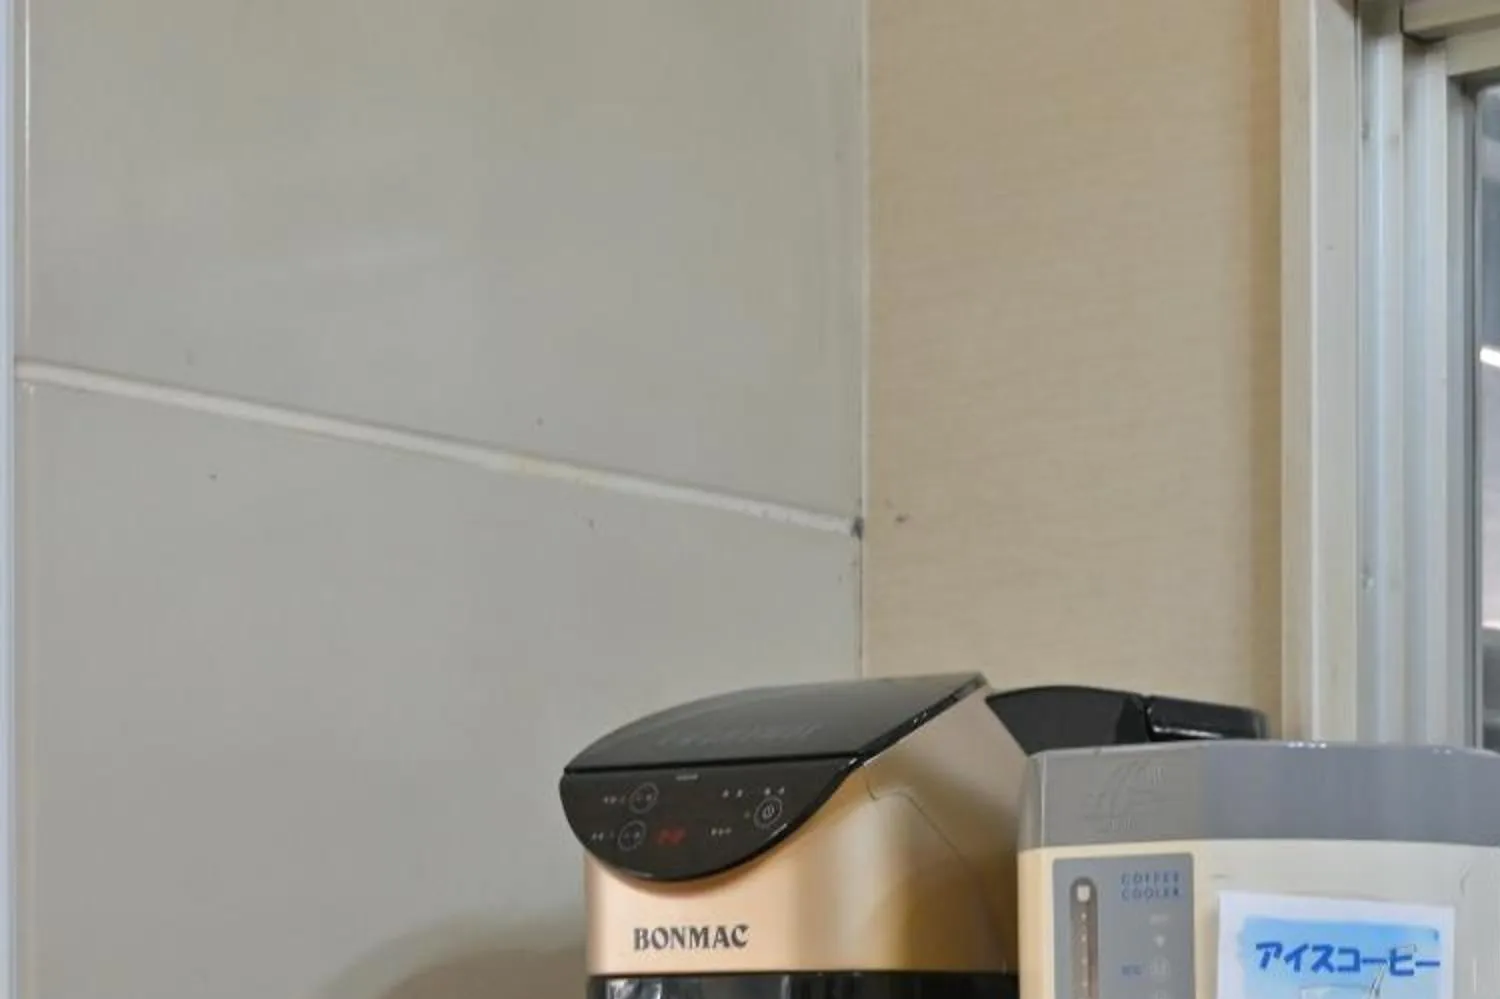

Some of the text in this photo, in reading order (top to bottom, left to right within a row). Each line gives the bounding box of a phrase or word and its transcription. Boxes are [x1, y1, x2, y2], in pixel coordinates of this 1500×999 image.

[633, 925, 749, 951] BONMAC
[1255, 942, 1441, 977] アイスコーヒー
